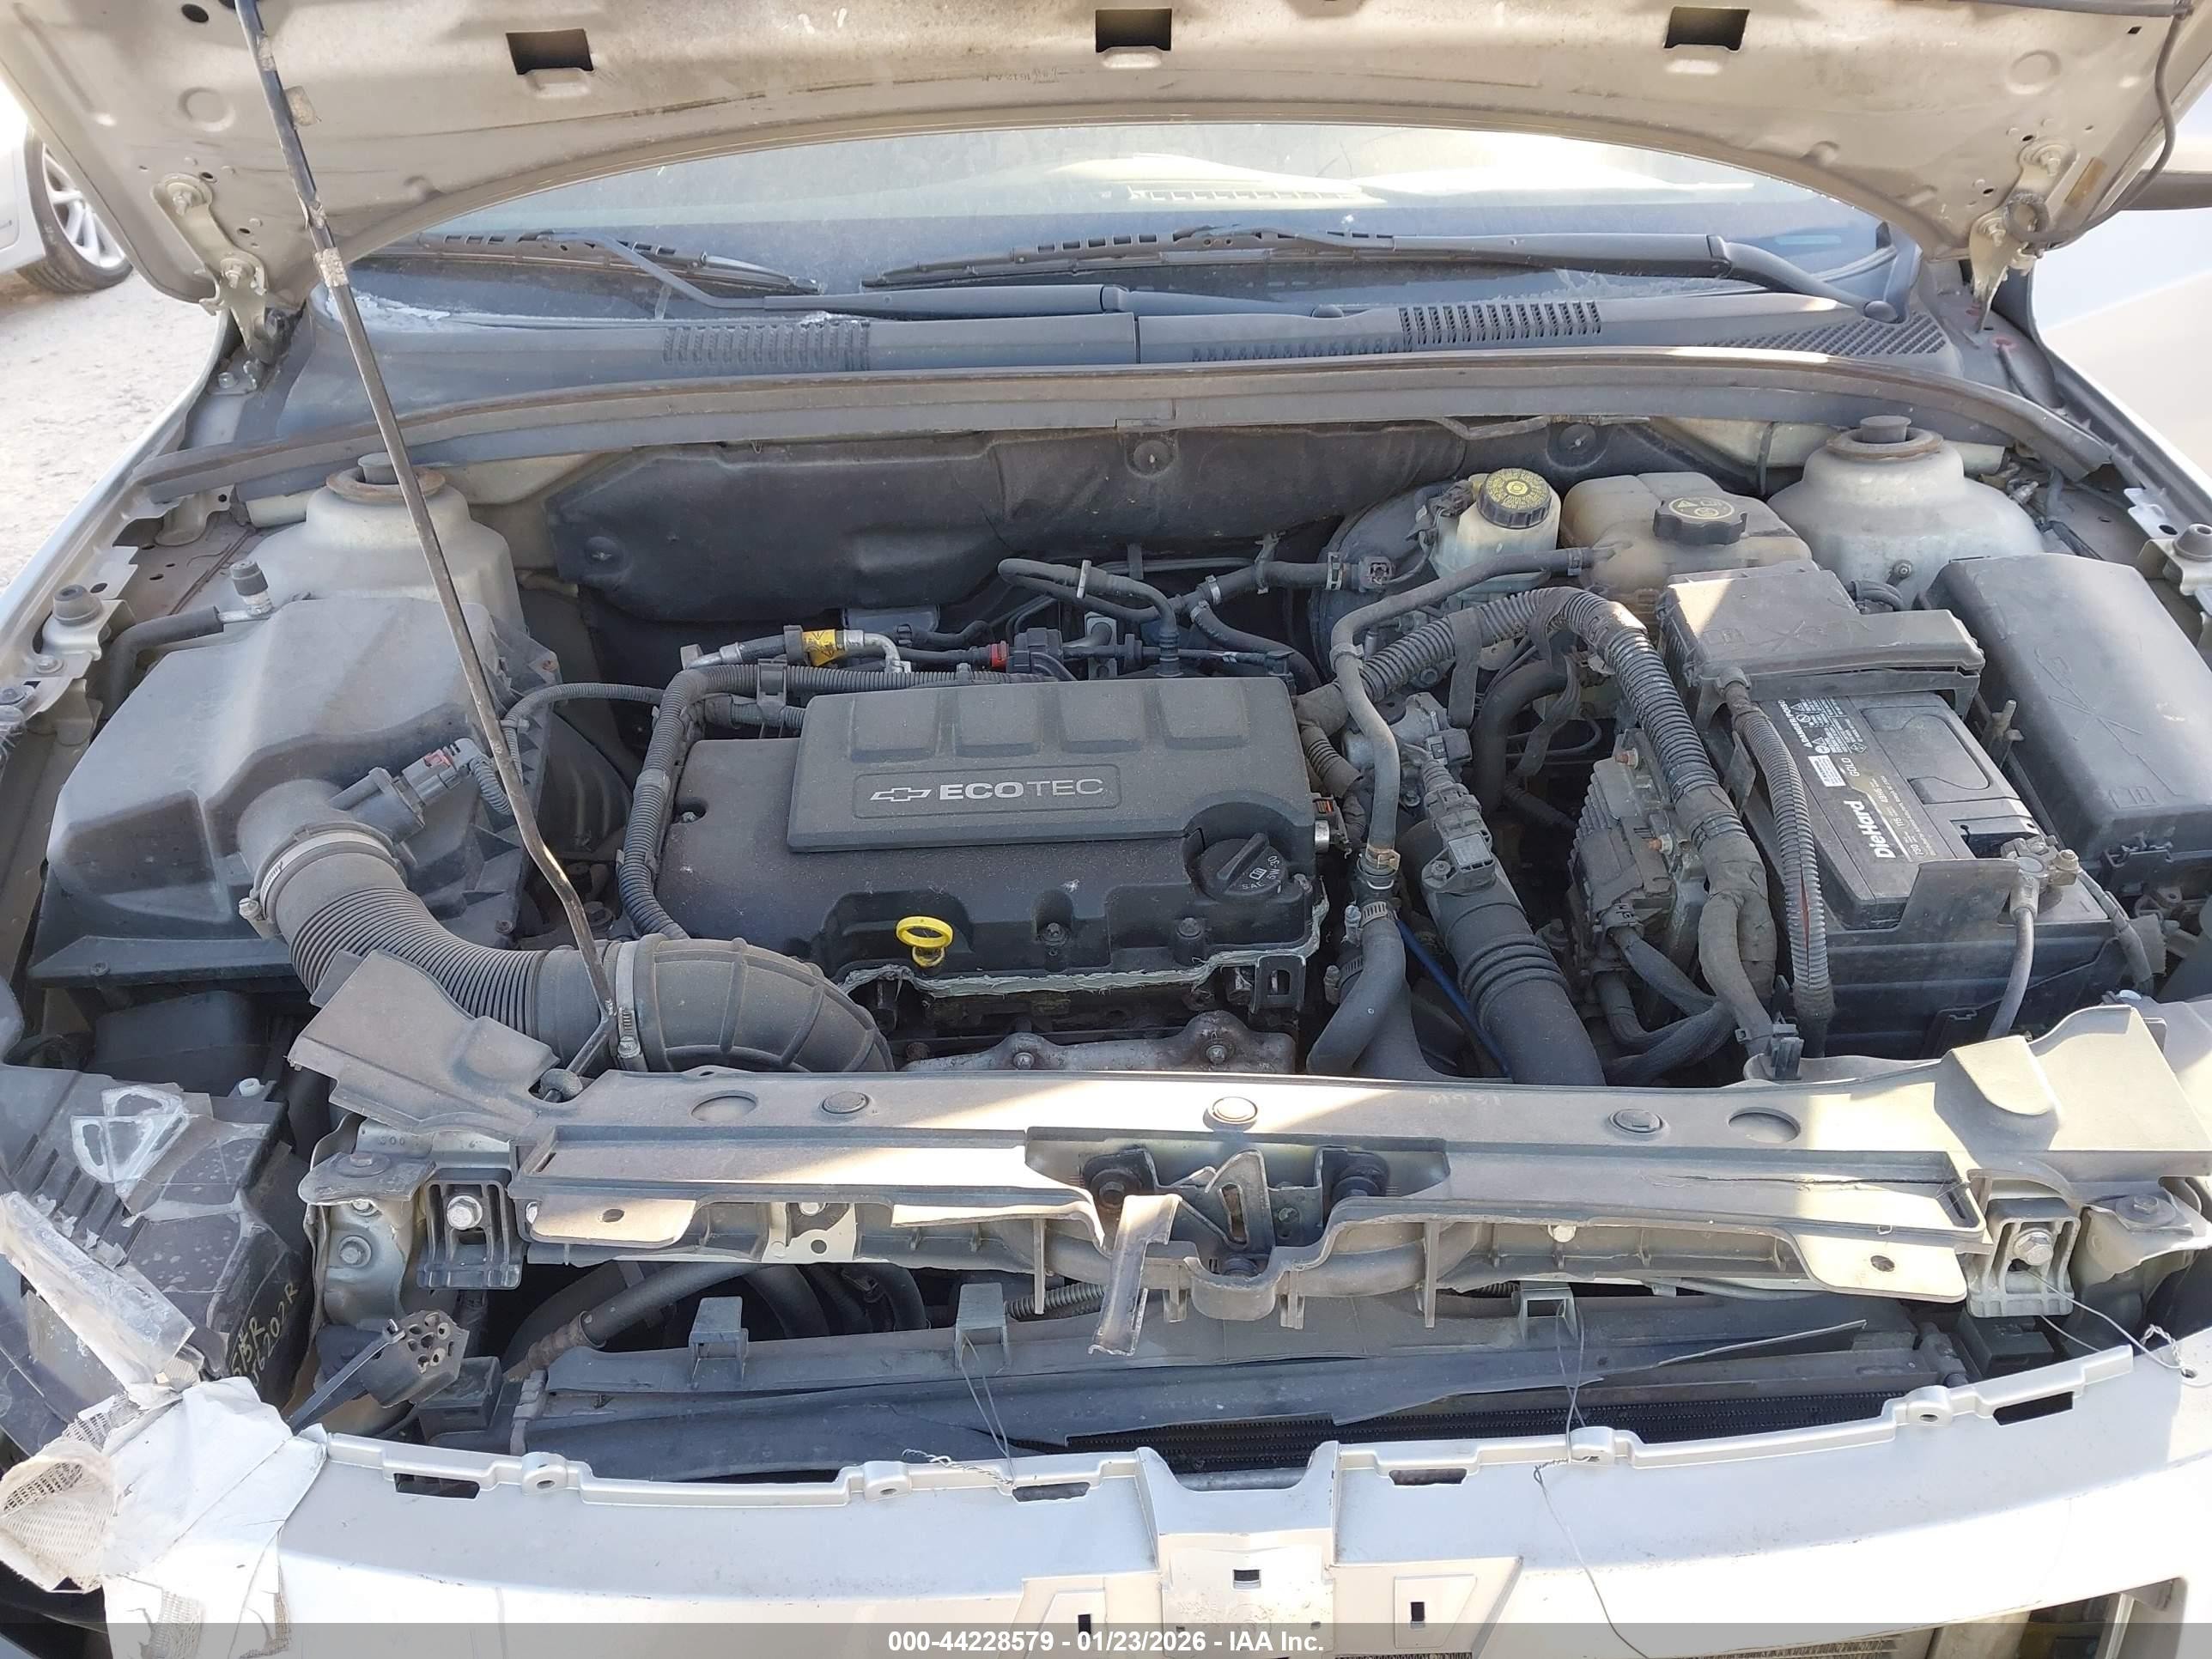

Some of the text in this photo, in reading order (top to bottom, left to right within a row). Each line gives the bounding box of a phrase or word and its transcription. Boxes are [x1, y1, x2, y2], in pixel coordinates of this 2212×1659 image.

[1841, 757, 1860, 777] GOLD
[939, 778, 1103, 801] ECOTEC
[1843, 800, 1896, 859] DieHard
[1242, 855, 1280, 890] SAE 5W-30
